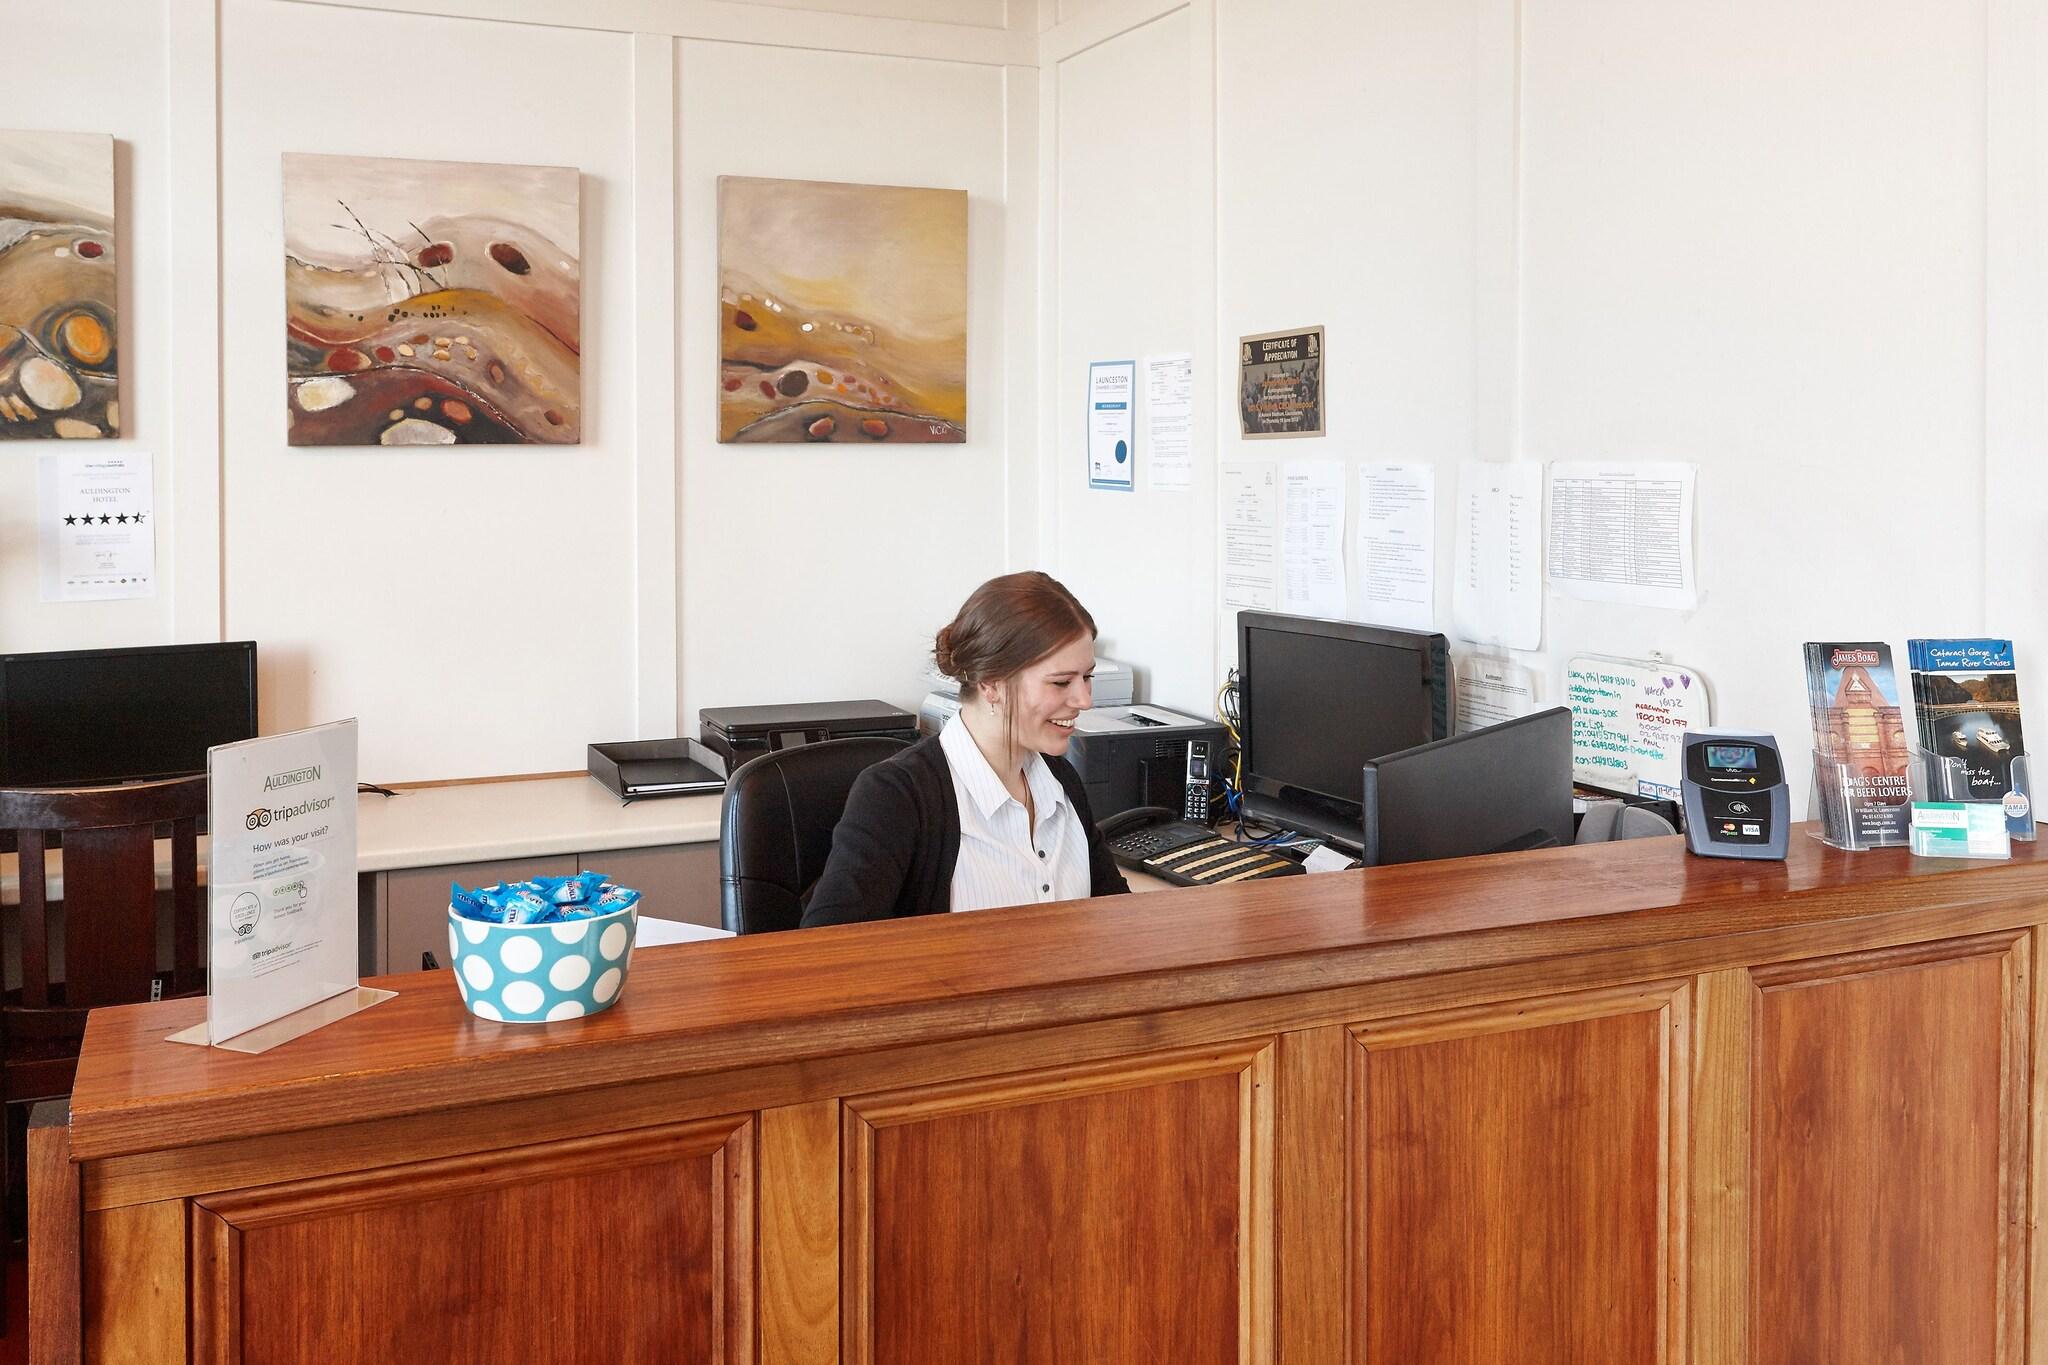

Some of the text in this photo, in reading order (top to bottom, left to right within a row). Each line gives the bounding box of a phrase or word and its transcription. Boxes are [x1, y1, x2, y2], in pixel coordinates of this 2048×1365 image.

[1262, 338, 1298, 351] CERTIFICATE OF
[1263, 350, 1298, 362] APPRECIATION
[1095, 375, 1128, 384] LAUNCESTON
[79, 487, 132, 496] AULDINGTON
[1832, 650, 1877, 666] JAMES BOAG
[1930, 648, 1966, 657] Cataract
[1967, 647, 1990, 659] Gorge
[1935, 657, 2011, 667] Tamar River Cruises
[1961, 766, 1991, 776] miss the
[263, 764, 321, 793] AULDINGTON
[1871, 775, 1906, 787] CENTRE
[1856, 786, 1878, 798] BEER
[1878, 785, 1914, 798] LOVERS
[273, 797, 334, 822] tripadvisor
[252, 825, 329, 854] How was your visit?
